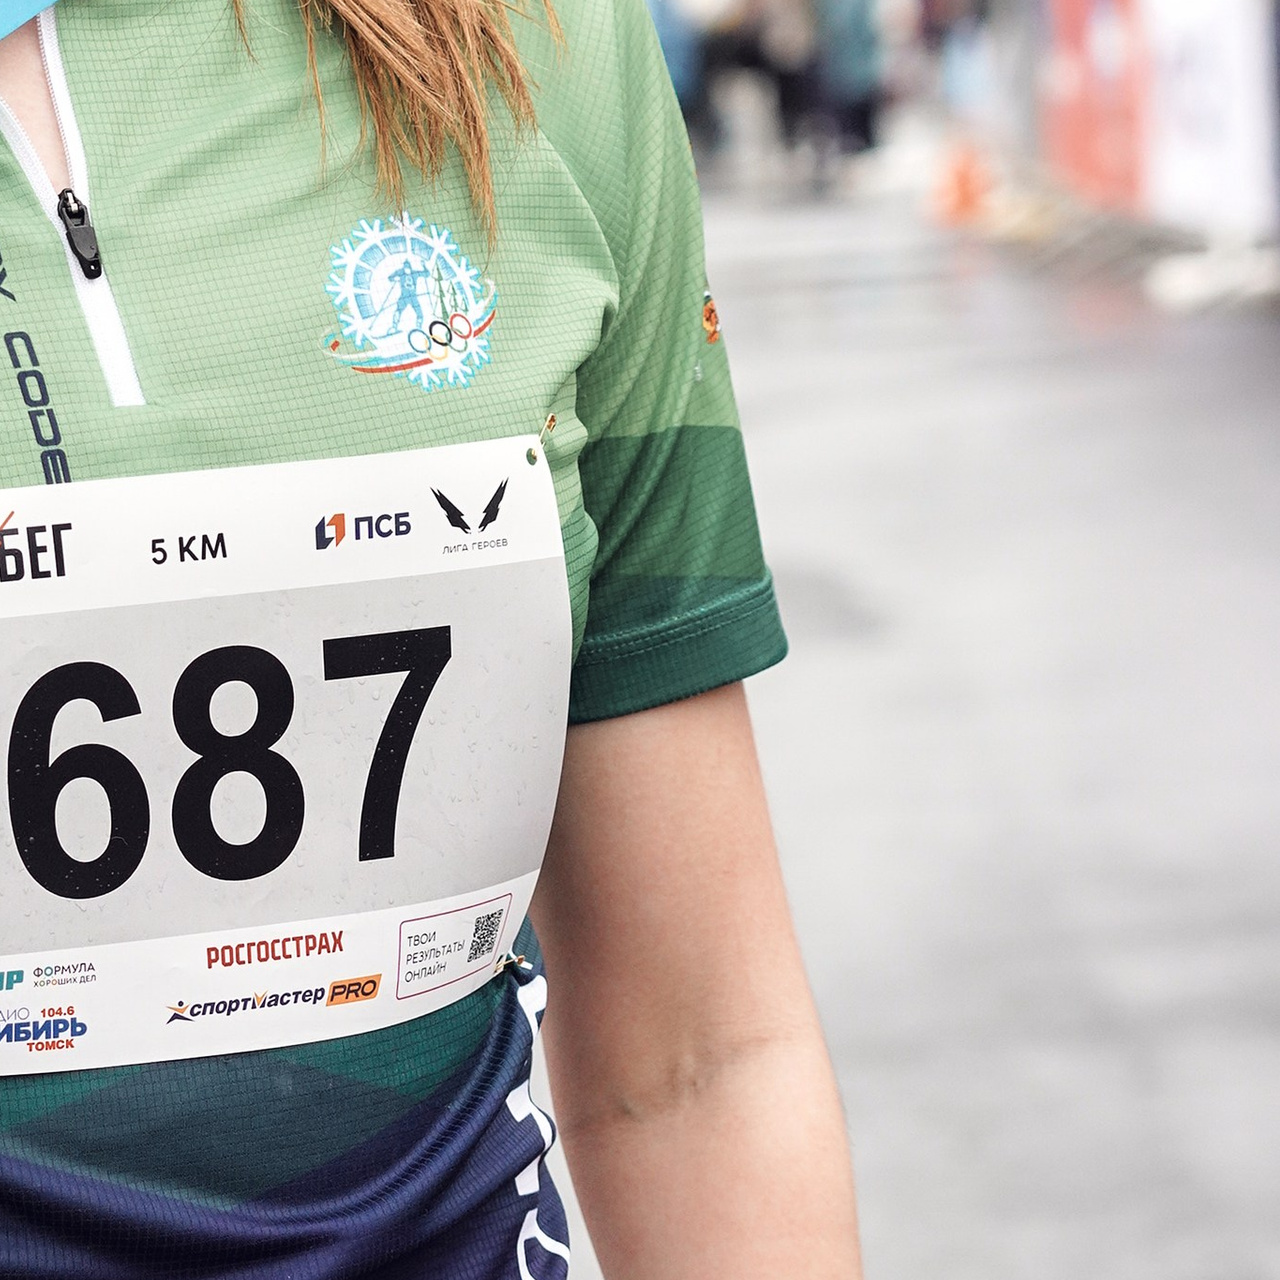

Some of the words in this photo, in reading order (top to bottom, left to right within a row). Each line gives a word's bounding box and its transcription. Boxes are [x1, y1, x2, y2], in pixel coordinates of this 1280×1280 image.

[2, 330, 72, 486] CODE
[354, 511, 412, 541] ПСБ
[150, 538, 168, 565] 5
[178, 532, 228, 563] КМ
[442, 540, 469, 555] ЛИГА
[471, 538, 509, 552] ГЕРОЕВ
[6, 624, 453, 901] 687
[206, 930, 344, 970] РОСГОССТРАХ
[407, 931, 437, 948] ТВОИ
[406, 940, 466, 965] РЕЗУЛЬТАТЫ
[33, 962, 96, 978] ФОРМУЛА
[33, 976, 78, 988] ХОРОШИХ
[79, 974, 97, 985] ДЕЛ
[404, 961, 447, 983] ОНЛАЙН
[330, 979, 377, 1002] PRO
[40, 1005, 75, 1018] 104.6
[26, 1038, 75, 1052] ТОМСК
